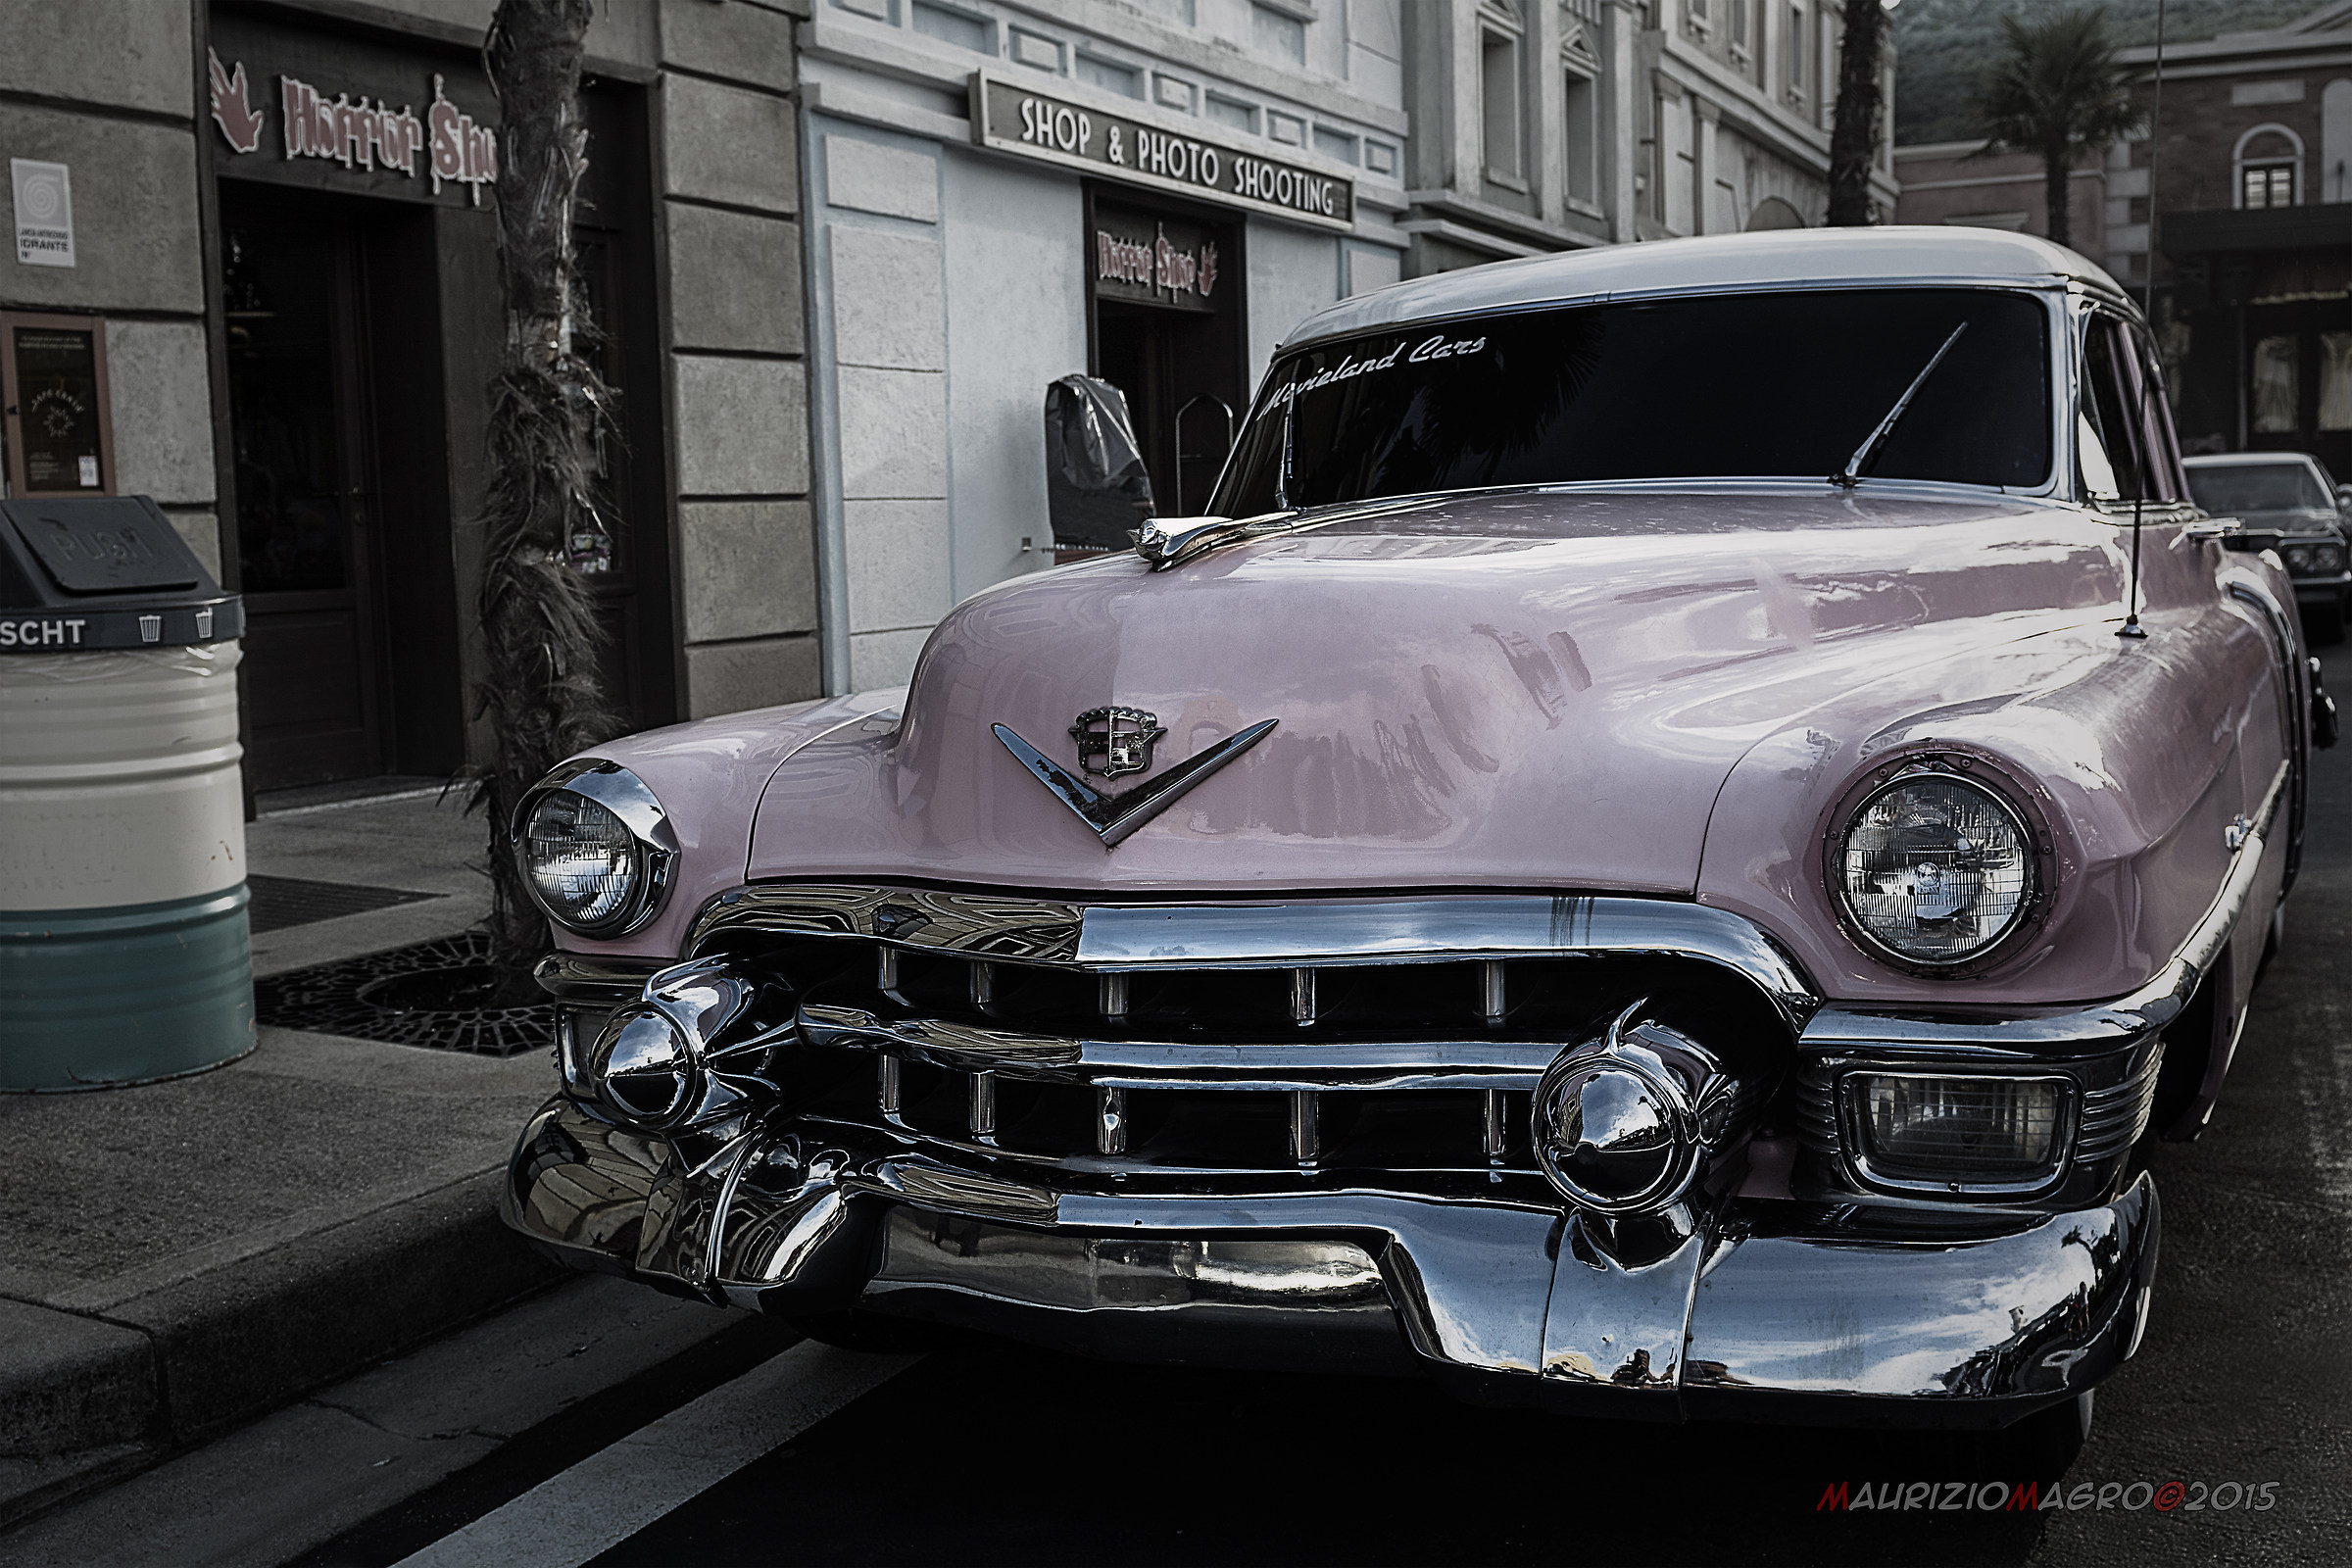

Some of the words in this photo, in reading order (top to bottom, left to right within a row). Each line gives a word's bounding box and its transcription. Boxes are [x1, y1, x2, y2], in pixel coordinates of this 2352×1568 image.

[280, 74, 423, 178] Horror
[427, 73, 498, 207] Sho
[1021, 98, 1092, 154] SHOP
[1108, 124, 1125, 165] &
[1137, 129, 1219, 186] PHOTO
[1234, 157, 1334, 216] SHOOTING
[20, 237, 70, 252] IDRANTE
[1097, 229, 1153, 287] Horror
[1154, 220, 1197, 305] Shop
[1408, 335, 1488, 364] Cars
[50, 529, 154, 562] PUSH
[0, 618, 87, 647] SCHT
